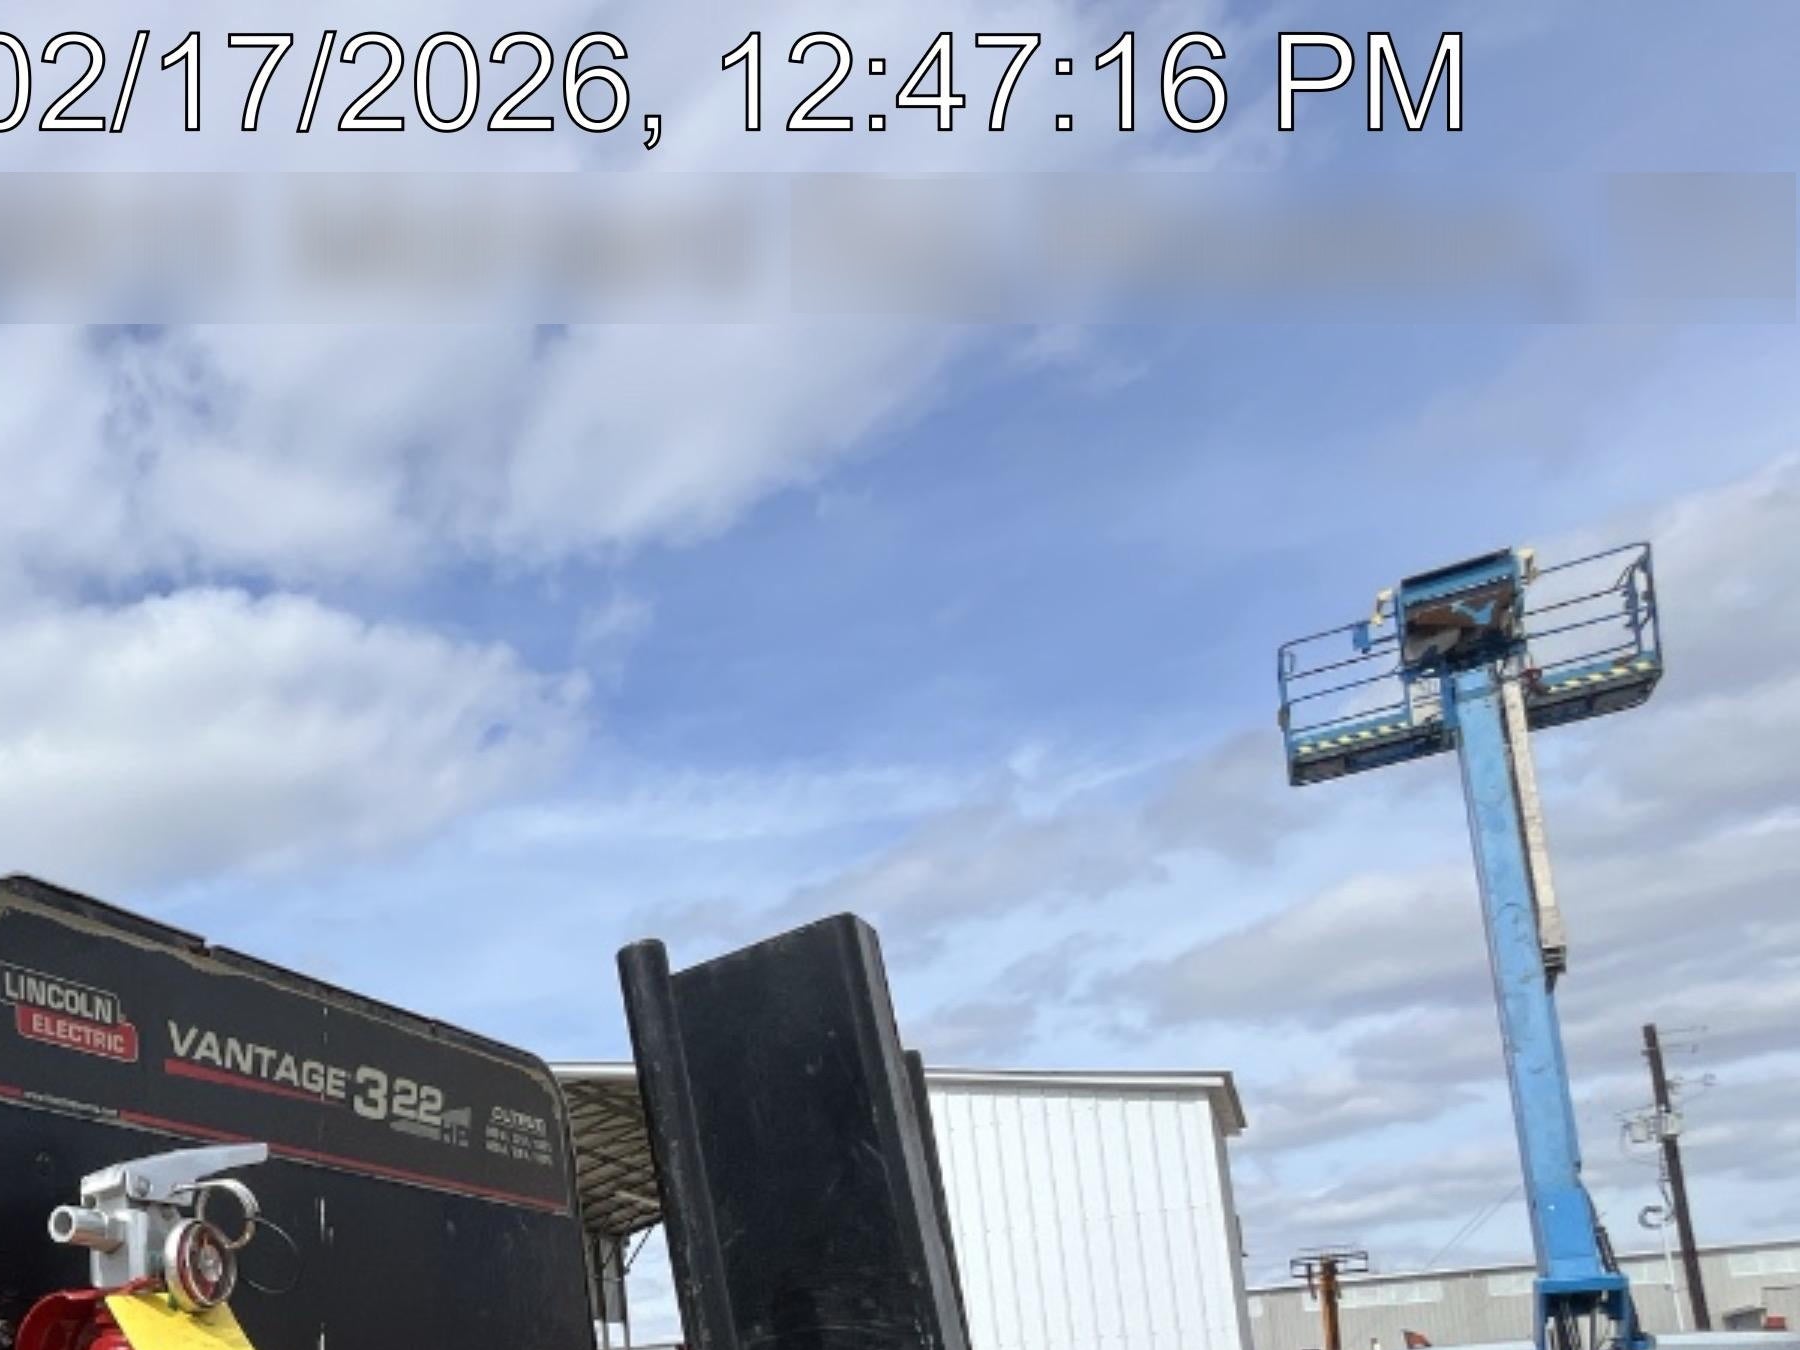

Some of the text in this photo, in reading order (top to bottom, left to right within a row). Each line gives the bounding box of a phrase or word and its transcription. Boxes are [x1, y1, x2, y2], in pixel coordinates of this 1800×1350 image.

[3, 970, 114, 1025] LINCOLN
[31, 1012, 125, 1054] ELECTRIC
[166, 1018, 348, 1101] VANTAGE
[352, 1065, 445, 1127] 322
